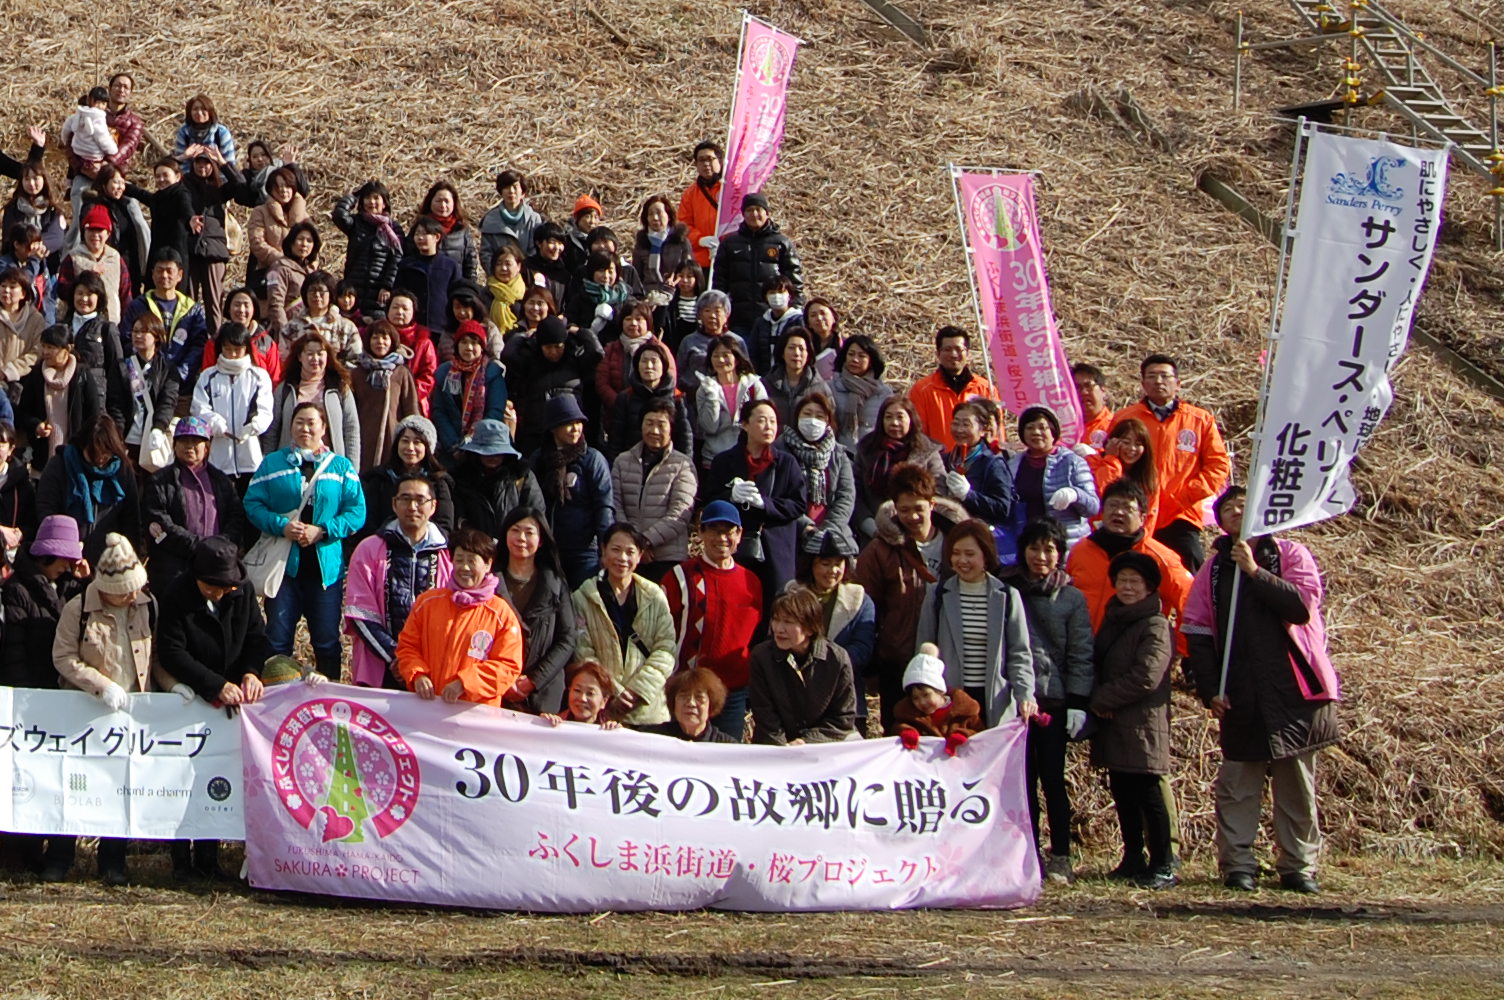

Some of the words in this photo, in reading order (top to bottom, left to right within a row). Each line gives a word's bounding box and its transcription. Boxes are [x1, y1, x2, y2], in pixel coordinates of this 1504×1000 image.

[1325, 194, 1368, 210] Sanders
[1370, 200, 1403, 217] Perry
[1315, 216, 1396, 503] サンダース・ペリー
[1263, 422, 1311, 527] 化粧品
[275, 703, 328, 791] ふくしま浜街道
[355, 709, 415, 803] 桜プロジェクト
[156, 786, 193, 798] charm
[453, 747, 991, 836] 30年後の故郷に贈る
[274, 858, 332, 878] SAKURA
[351, 864, 420, 885] PROJECT
[528, 831, 942, 887] ふくしま浜街道・桜プロジェクト
